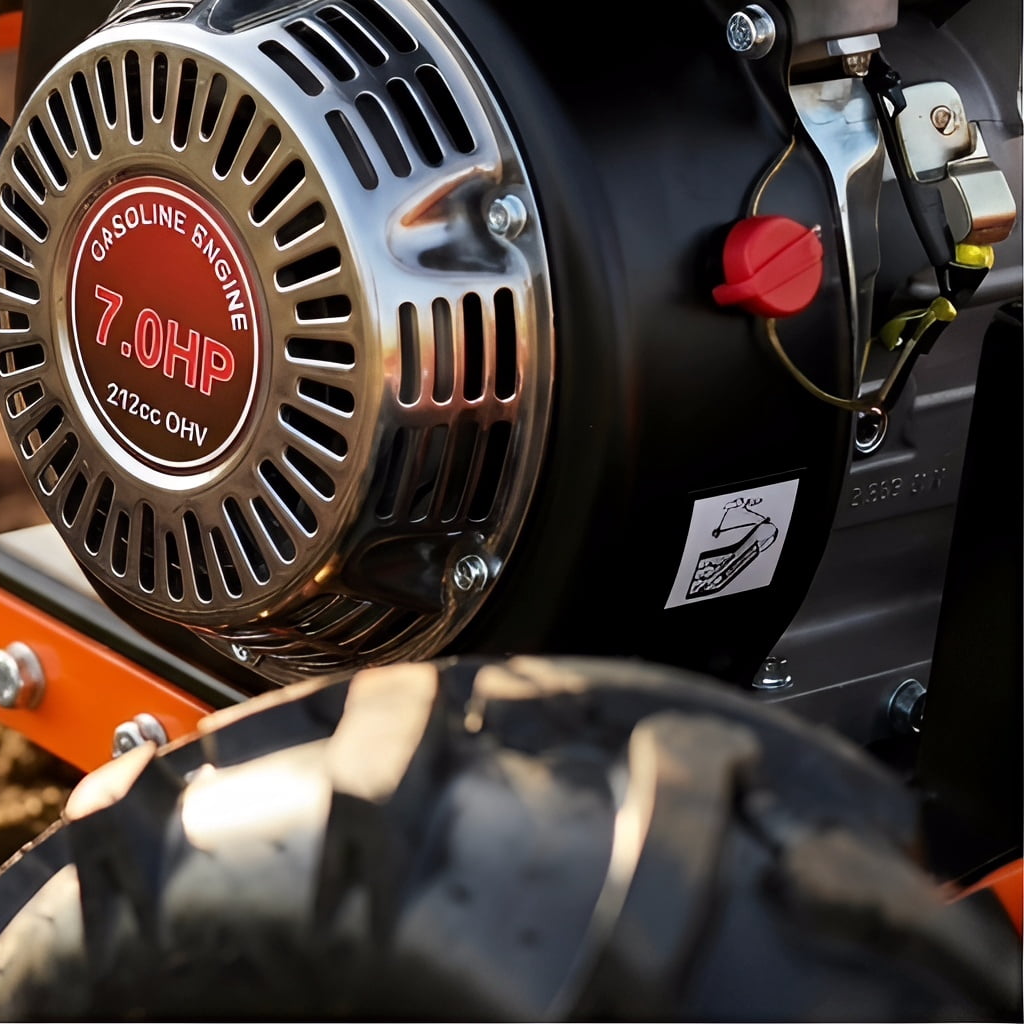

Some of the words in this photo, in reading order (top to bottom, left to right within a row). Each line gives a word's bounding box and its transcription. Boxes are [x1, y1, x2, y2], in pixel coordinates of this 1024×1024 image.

[95, 284, 235, 396] 7.0HP
[106, 383, 161, 425] 212cc
[166, 411, 208, 447] OHV
